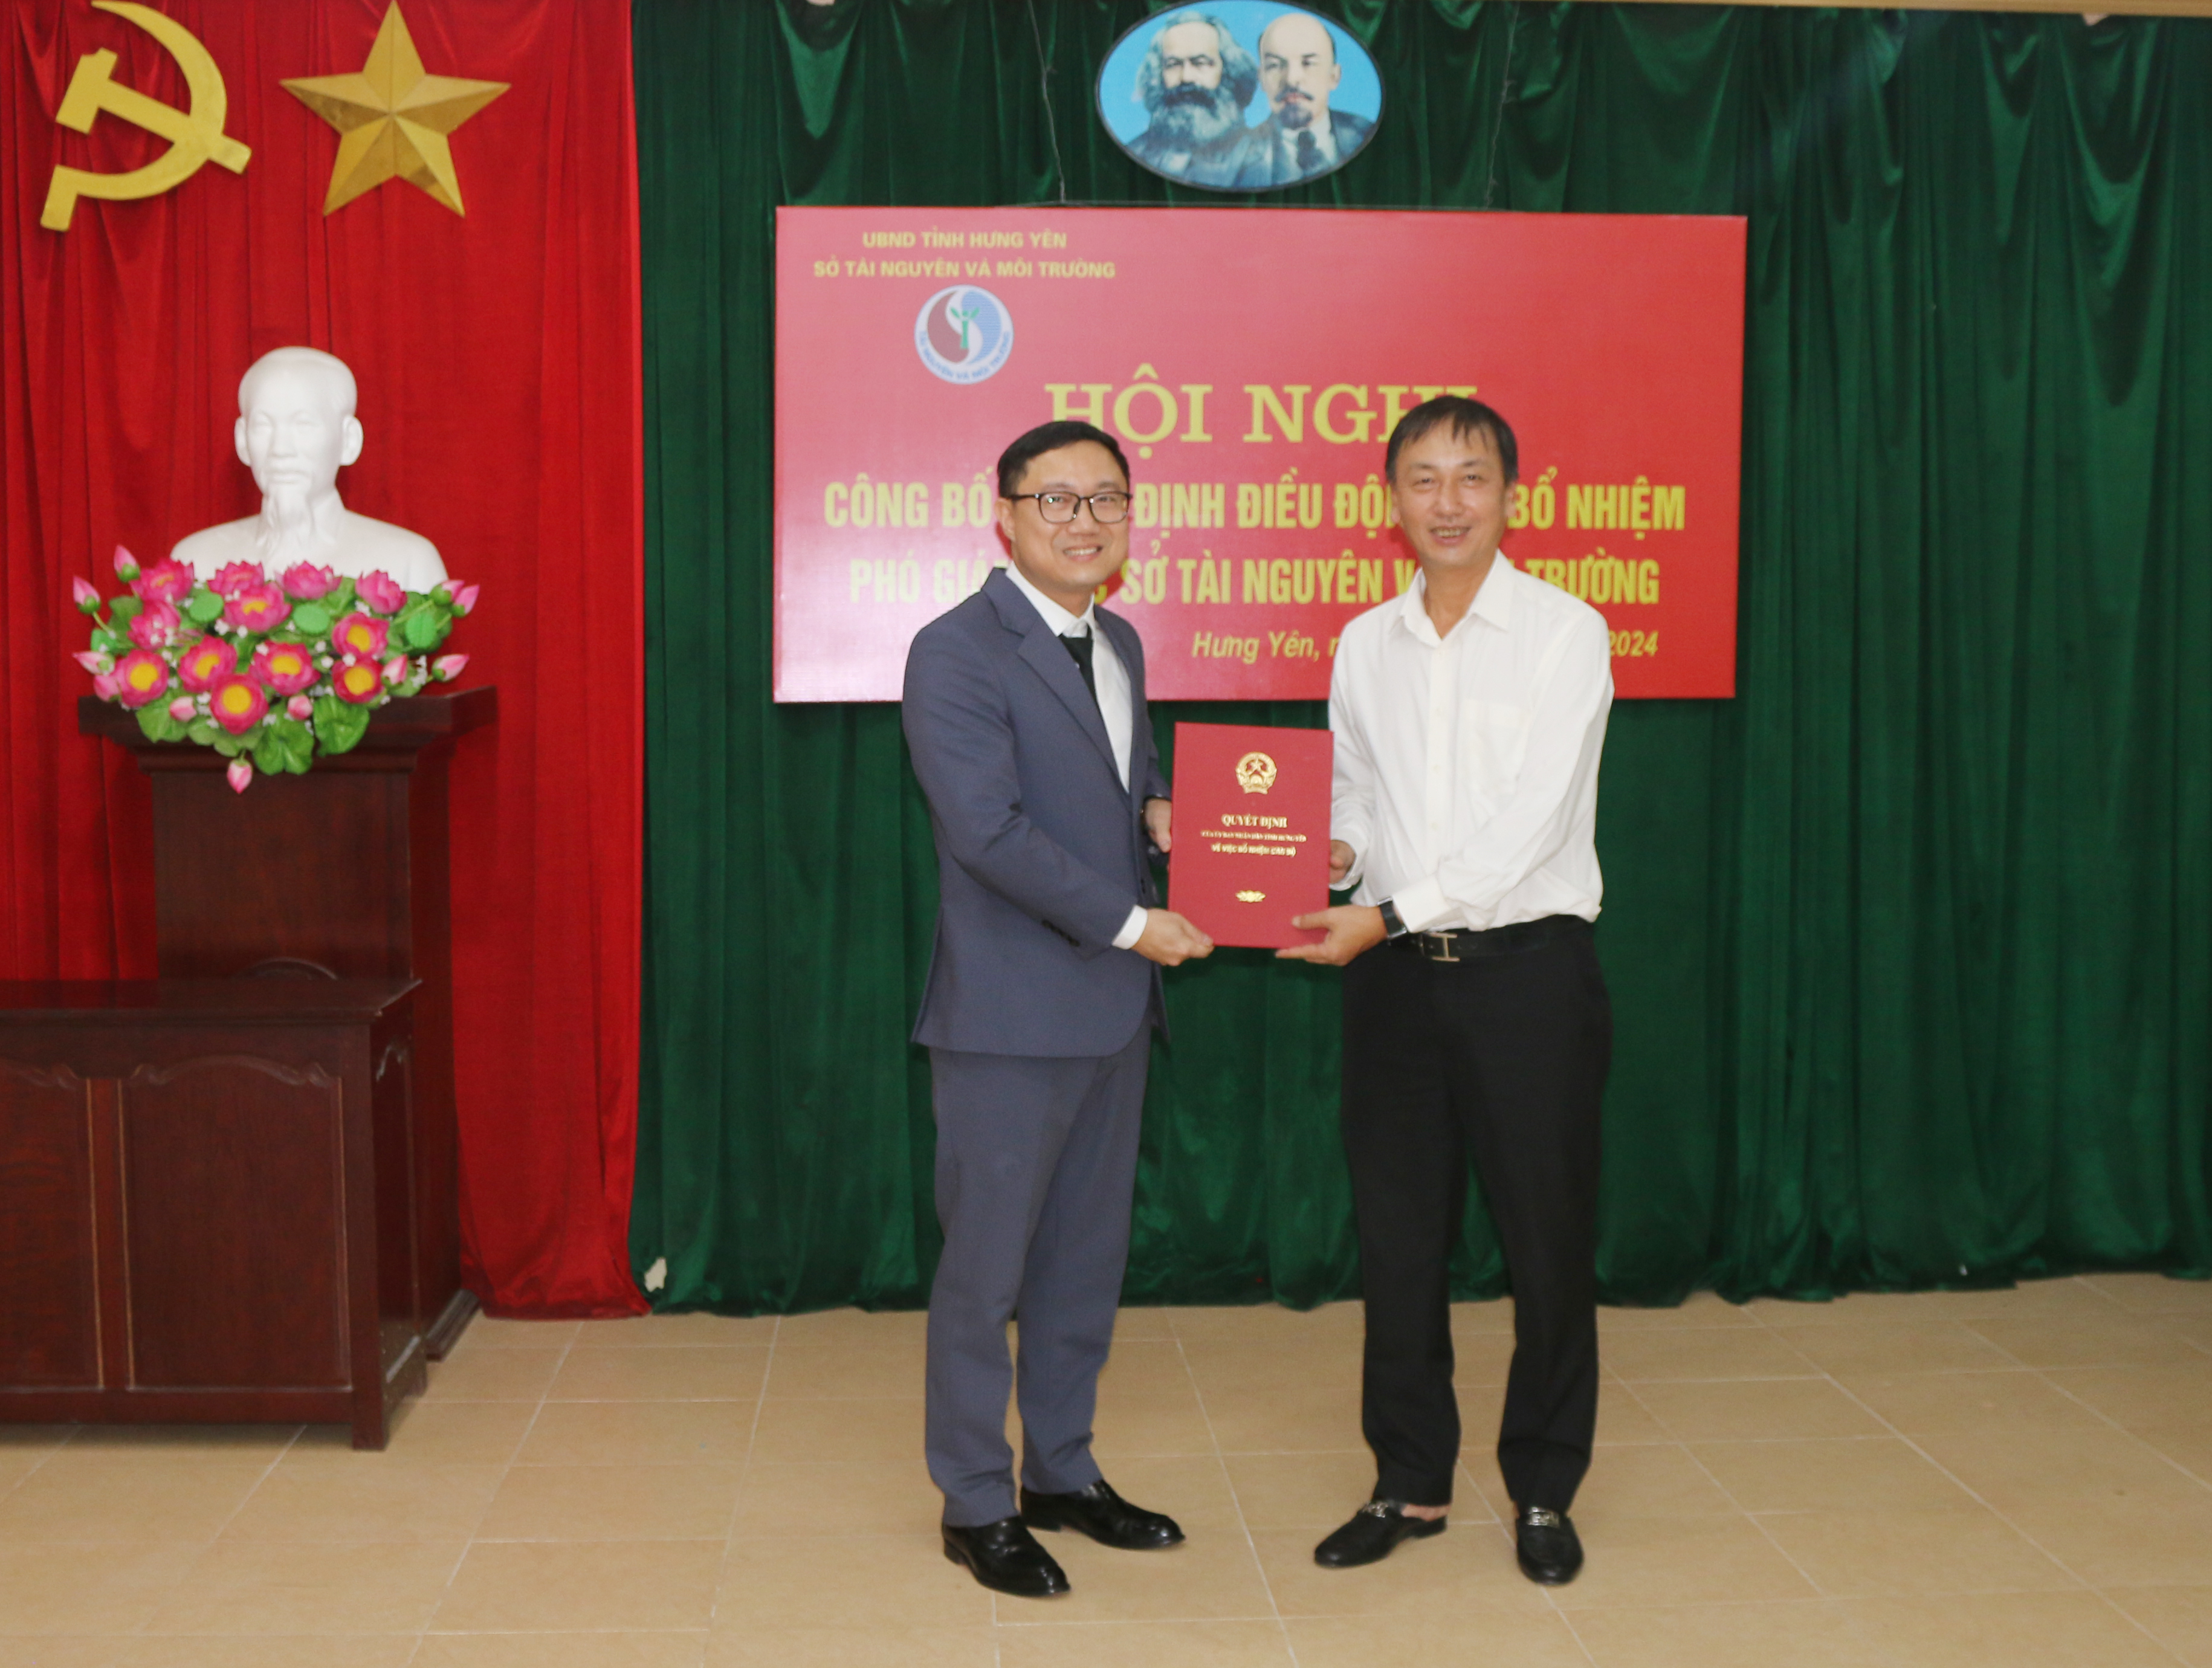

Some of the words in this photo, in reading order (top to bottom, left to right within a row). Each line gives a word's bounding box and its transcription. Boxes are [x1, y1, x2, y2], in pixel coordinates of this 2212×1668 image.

[862, 231, 916, 248] UBND
[920, 226, 964, 248] TỈNH
[969, 231, 1024, 248] HƯNG
[1029, 228, 1067, 248] YÊN
[814, 254, 839, 277] SỞ
[845, 258, 875, 277] TÀI
[880, 257, 960, 277] NGUYÊN
[997, 257, 1032, 277] MÔI
[1038, 257, 1116, 278] TRƯỜNG
[1044, 363, 1213, 459] HỘI
[1243, 384, 1478, 443] NGH
[824, 472, 929, 528] CÔNG
[942, 466, 994, 528] BỐ
[1134, 483, 1226, 539] ĐỊNH
[1236, 466, 1323, 529] ĐIỀU
[1334, 473, 1394, 539] ĐỘ
[1507, 465, 1558, 529] BỔ
[1567, 475, 1685, 541] NHIỆM
[850, 549, 920, 603] PHÓ
[935, 549, 1008, 603] GIÁ
[1119, 539, 1169, 604] SỞ
[1177, 548, 1232, 604] TÀI
[1243, 549, 1383, 604] NGUYÊN
[1394, 558, 1416, 596] V
[1191, 630, 1260, 665] Hưng
[1268, 629, 1320, 662] Yên,
[1221, 813, 1259, 827] QUYẾT
[1260, 816, 1287, 829] ĐỊNH
